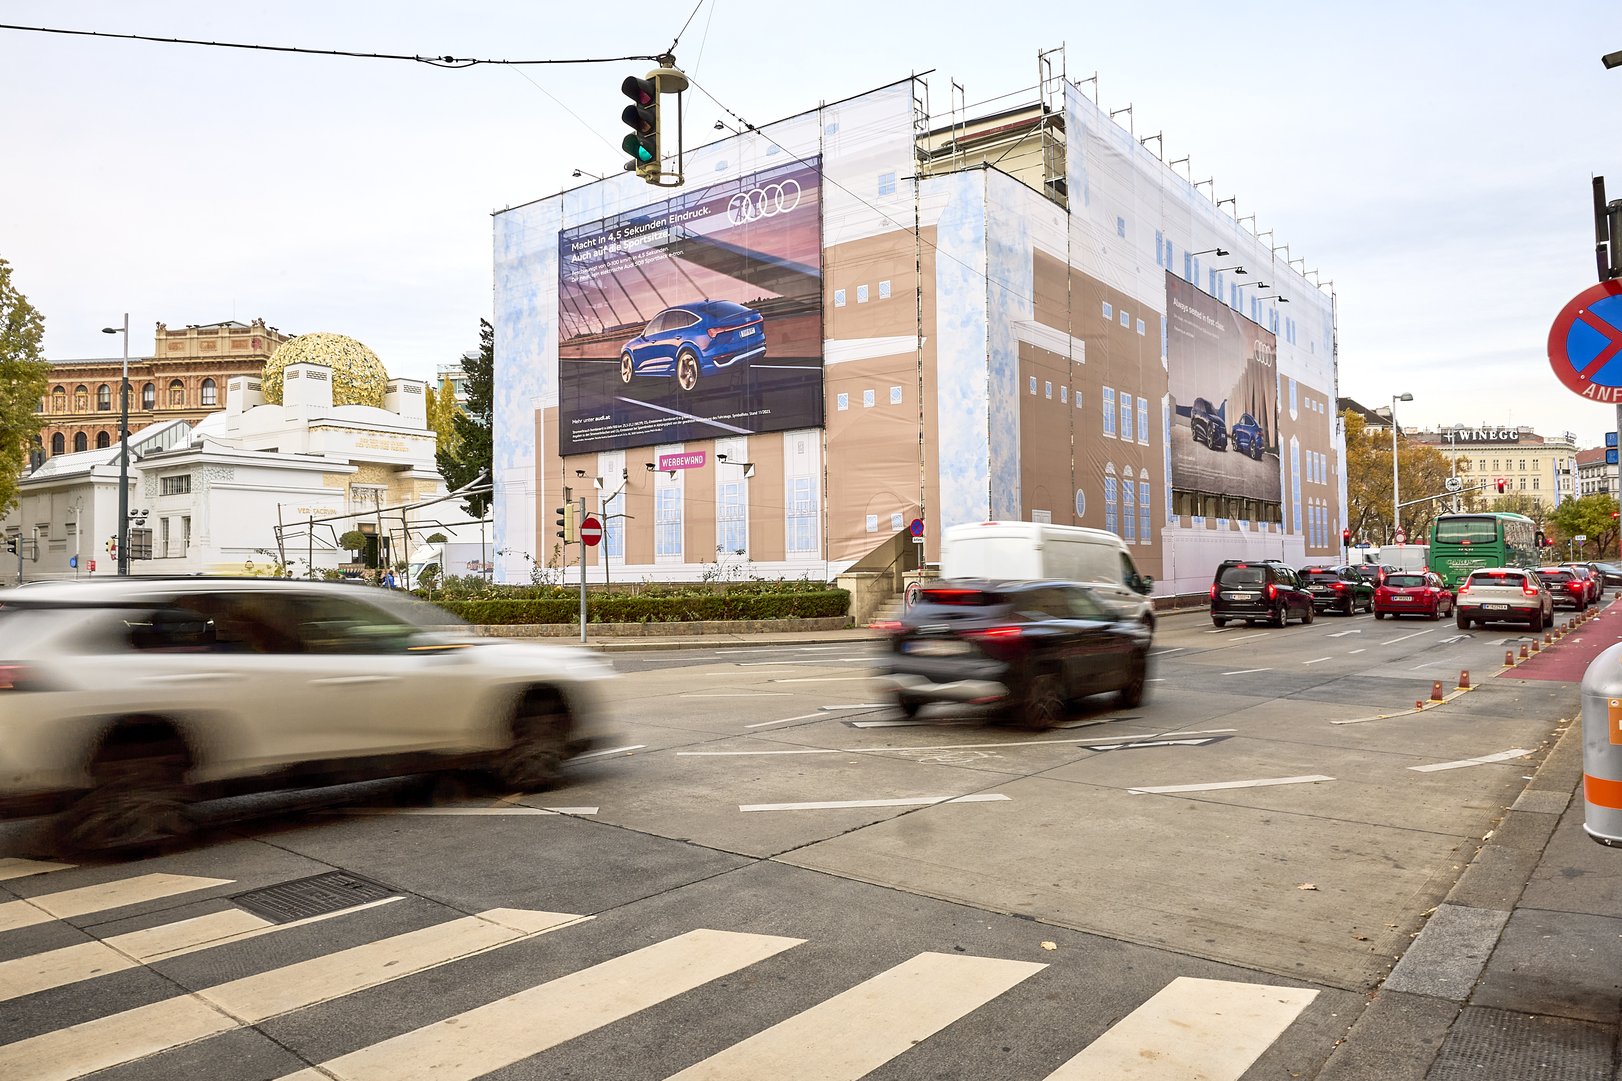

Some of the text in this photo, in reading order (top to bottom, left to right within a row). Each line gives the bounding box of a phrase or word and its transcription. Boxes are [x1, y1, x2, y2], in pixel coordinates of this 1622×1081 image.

[571, 206, 712, 251] Macht in 4,5 Sekunden Eindruck.
[571, 231, 671, 263] Auch auf die Sportsitze.
[1459, 430, 1519, 441] WINEGG
[661, 455, 704, 468] WERBEWAND
